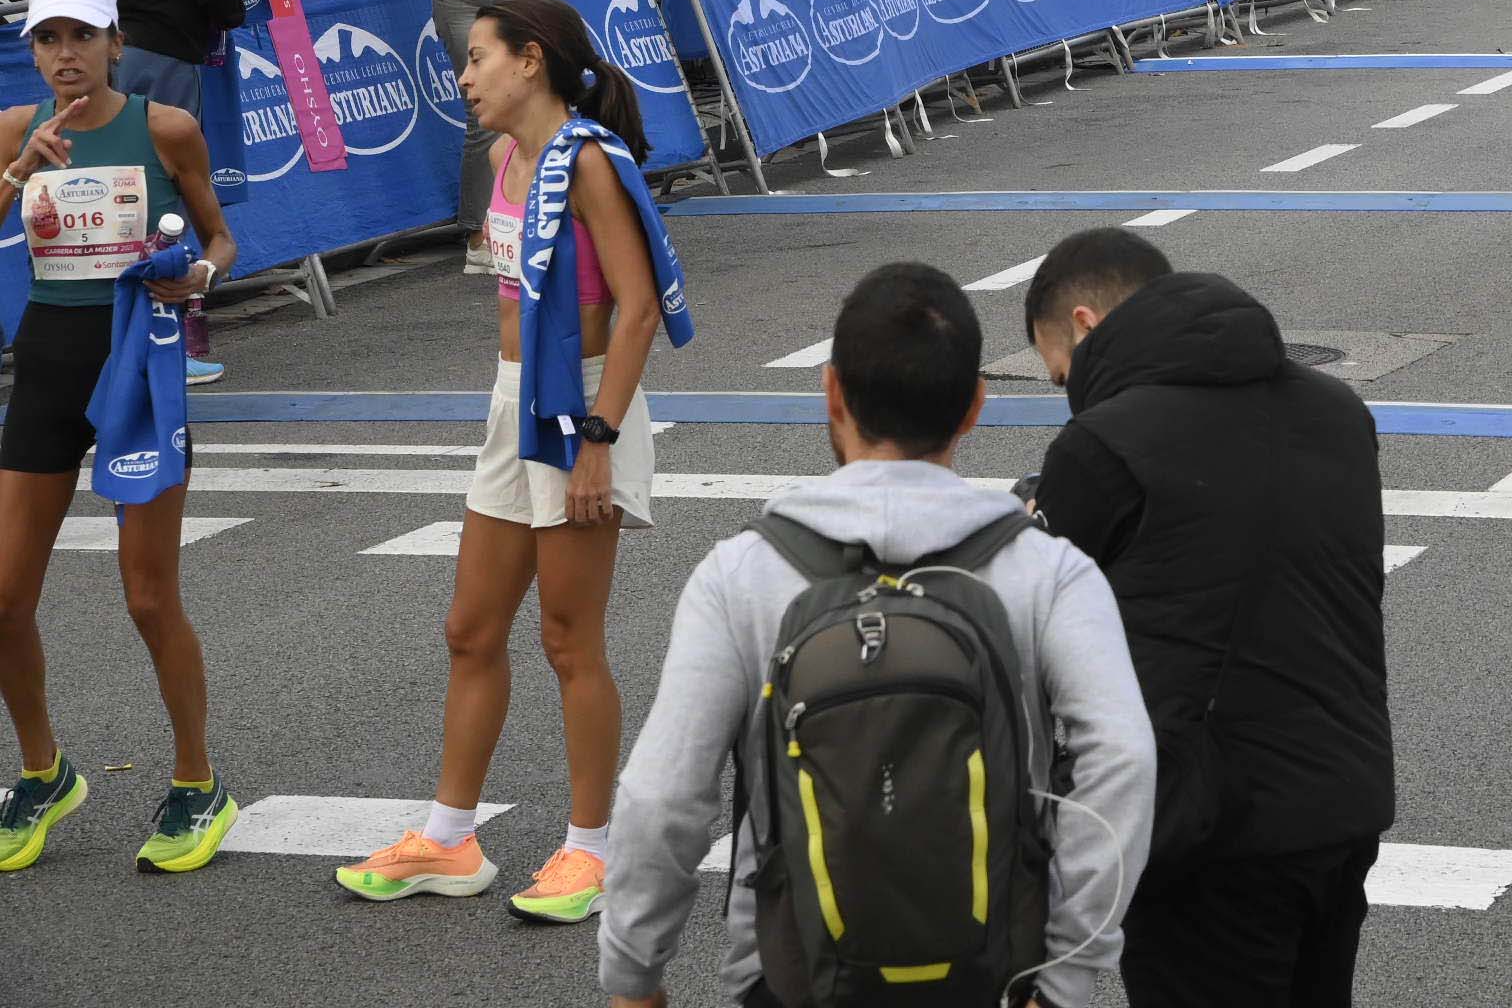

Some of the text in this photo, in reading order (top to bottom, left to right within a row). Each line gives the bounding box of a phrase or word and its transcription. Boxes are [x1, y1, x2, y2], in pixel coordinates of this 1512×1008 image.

[361, 61, 398, 80] LECHERA
[294, 53, 328, 148] OYSHO
[329, 79, 414, 126] STURIANA
[63, 211, 104, 229] 016
[81, 233, 89, 243] 5
[492, 240, 514, 259] 016
[44, 262, 75, 272] OYSHO
